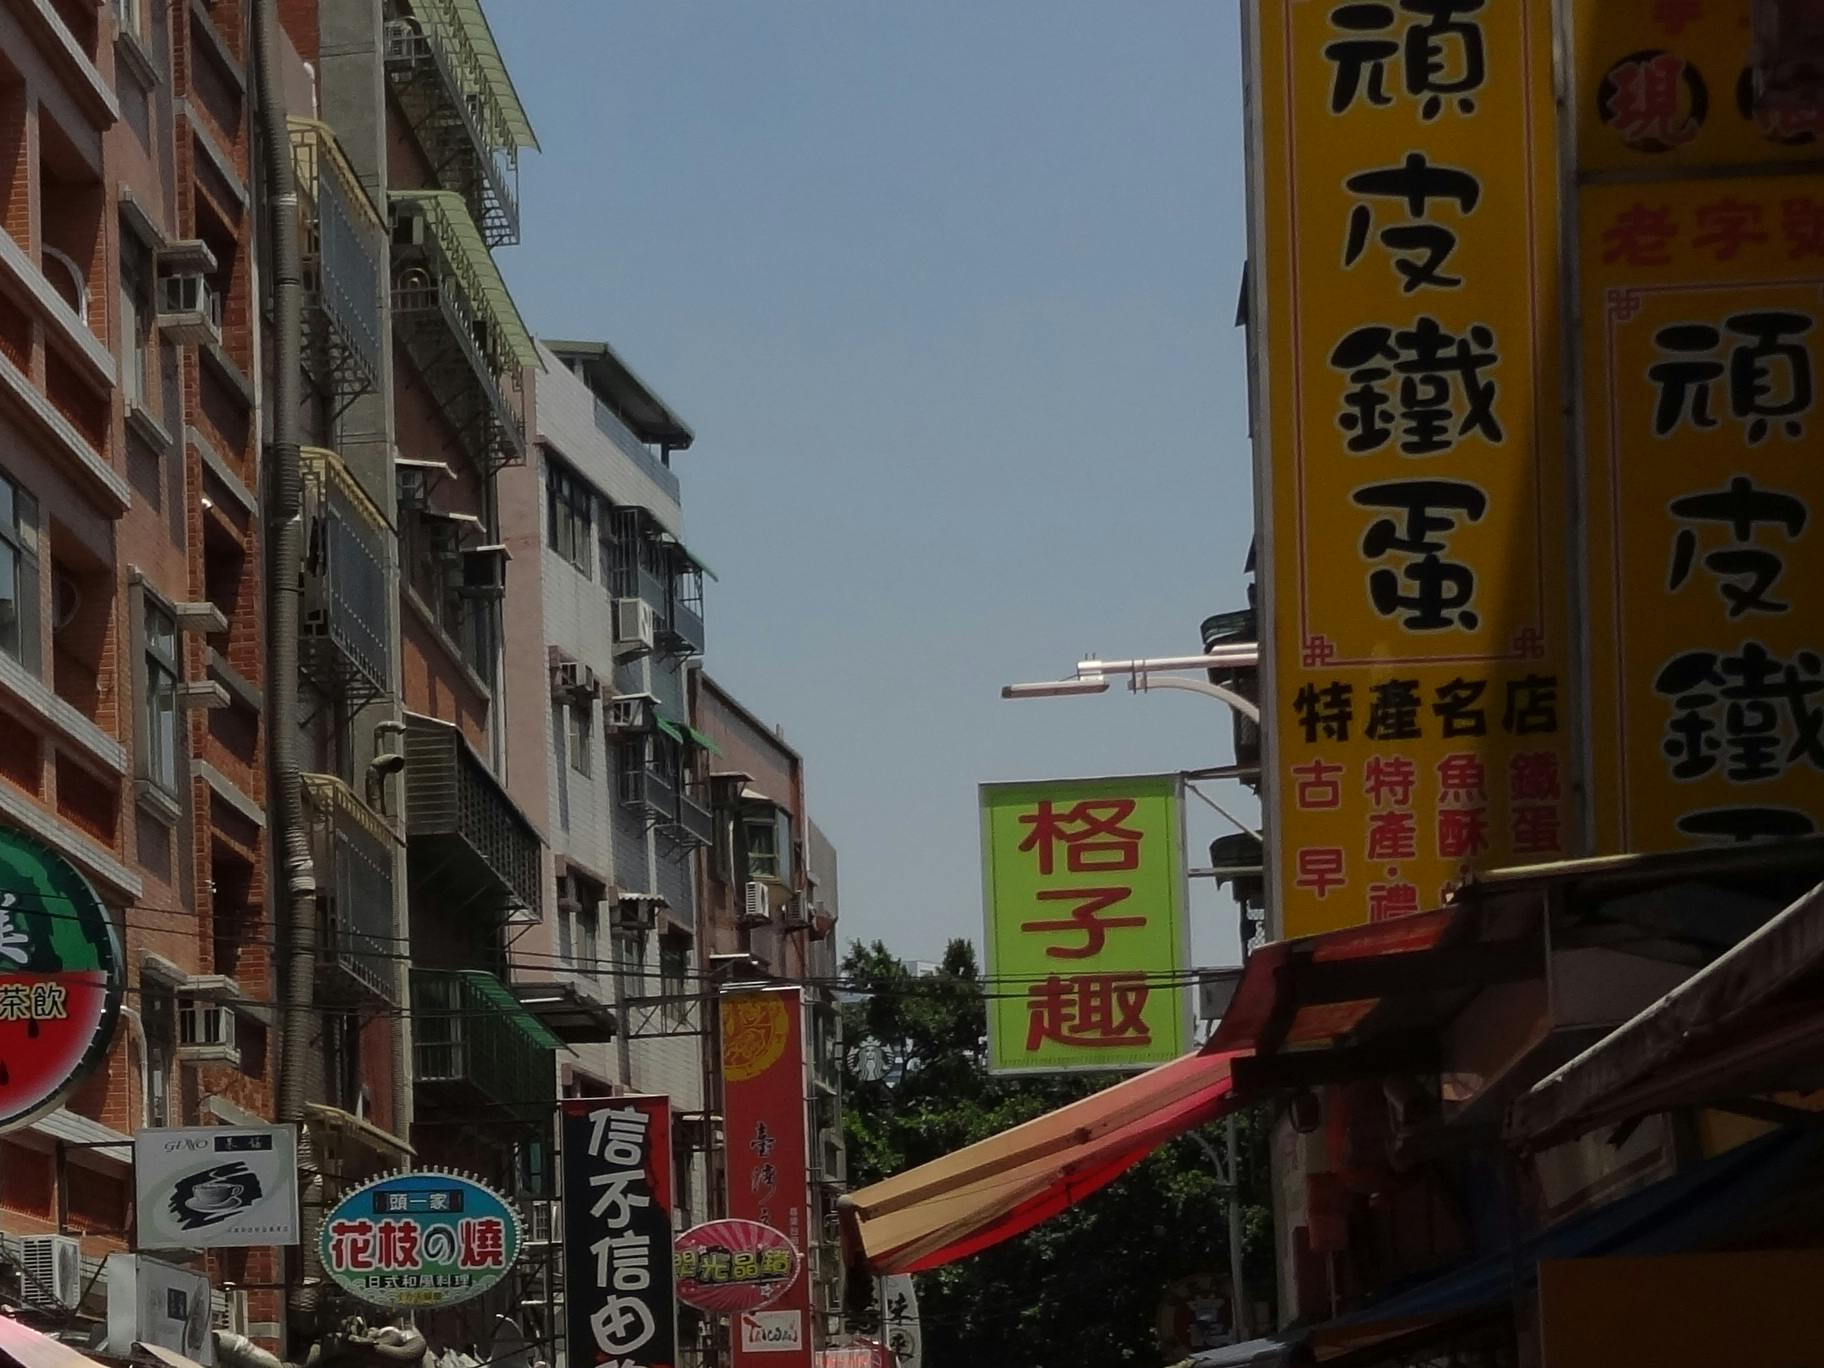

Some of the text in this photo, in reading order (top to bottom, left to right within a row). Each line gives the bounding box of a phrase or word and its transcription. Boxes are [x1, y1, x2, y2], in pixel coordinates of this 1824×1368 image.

[1325, 0, 1503, 631] 頑皮鐵蛋
[1648, 312, 1823, 842] 頑皮鐵
[1293, 673, 1559, 743] 特產名店
[1018, 799, 1152, 1051] 格子趣
[389, 1193, 448, 1211] 頭一家
[330, 1218, 505, 1270] 花枝の燒
[368, 1274, 472, 1289] 日式和風料理
